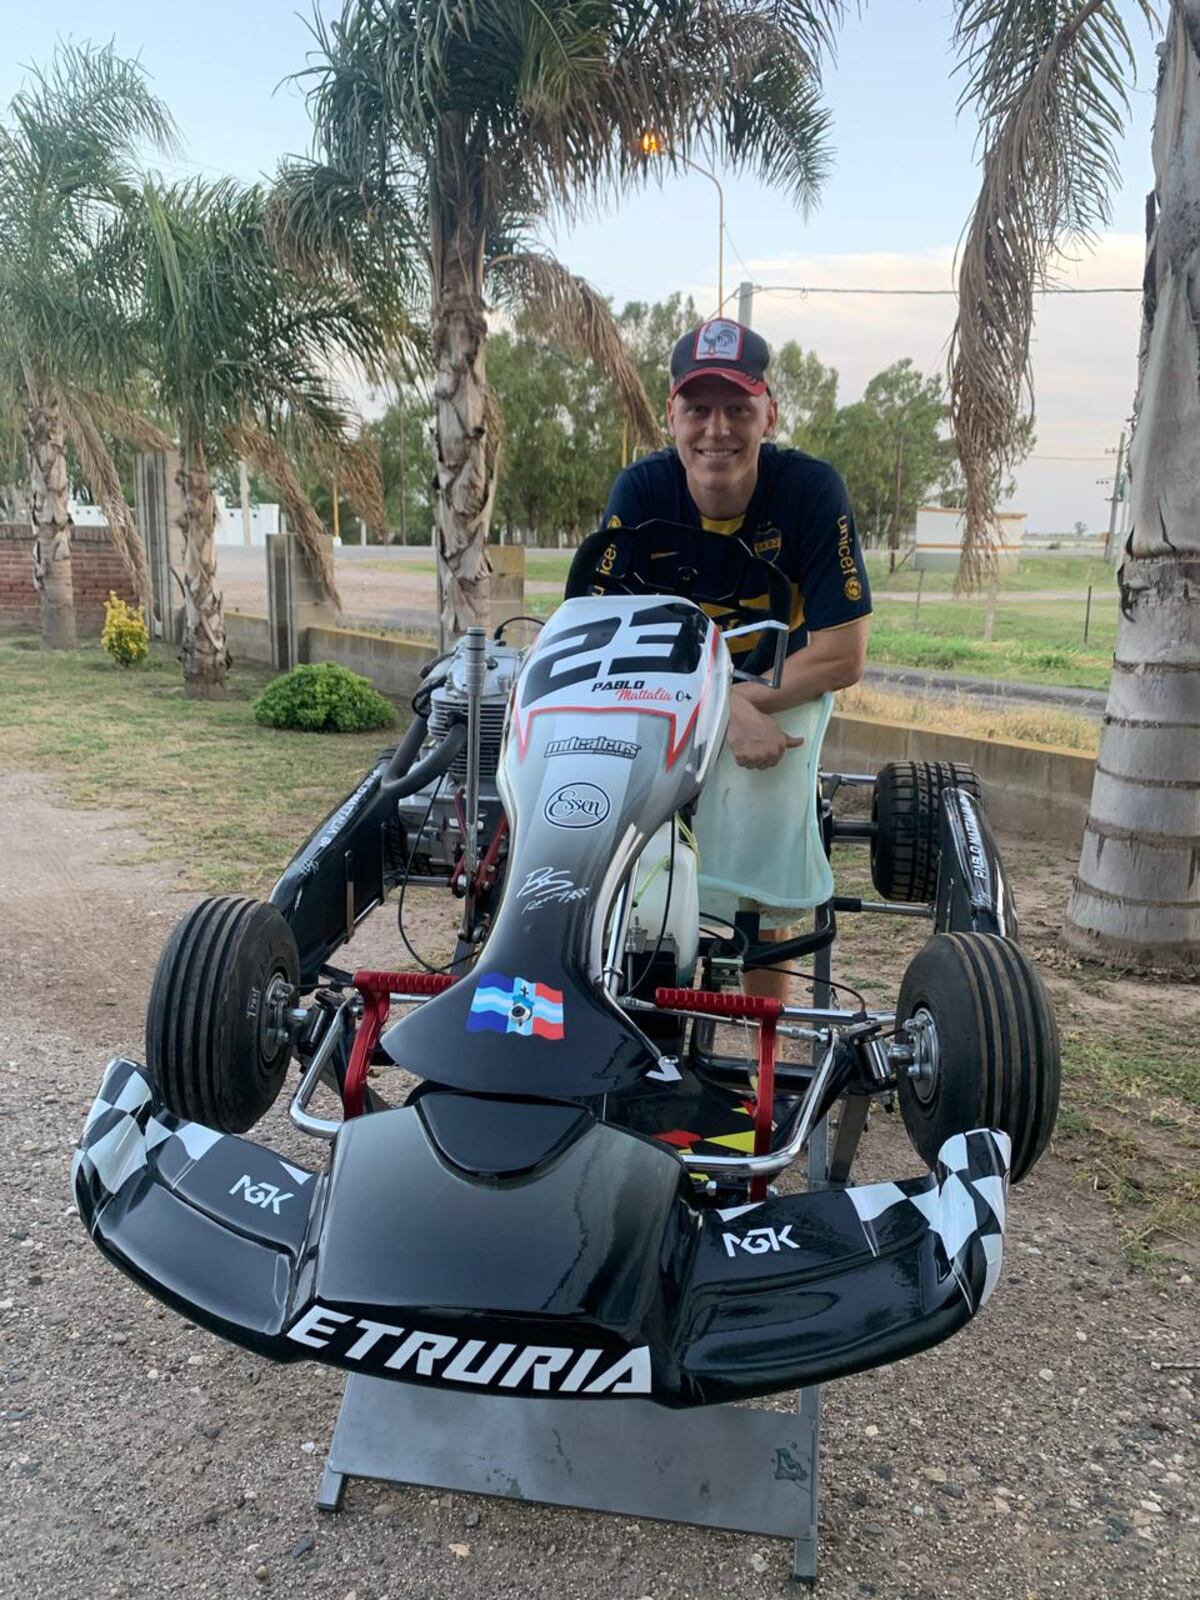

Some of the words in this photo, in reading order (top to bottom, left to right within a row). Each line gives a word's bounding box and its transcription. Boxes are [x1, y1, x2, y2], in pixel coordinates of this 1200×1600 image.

[837, 515, 858, 576] unicef
[521, 602, 711, 709] 23
[591, 680, 645, 692] PABLO
[549, 790, 606, 820] Essen
[229, 1174, 295, 1215] NGK
[722, 1224, 800, 1257] NGK
[286, 1305, 652, 1393] ETRURIA
